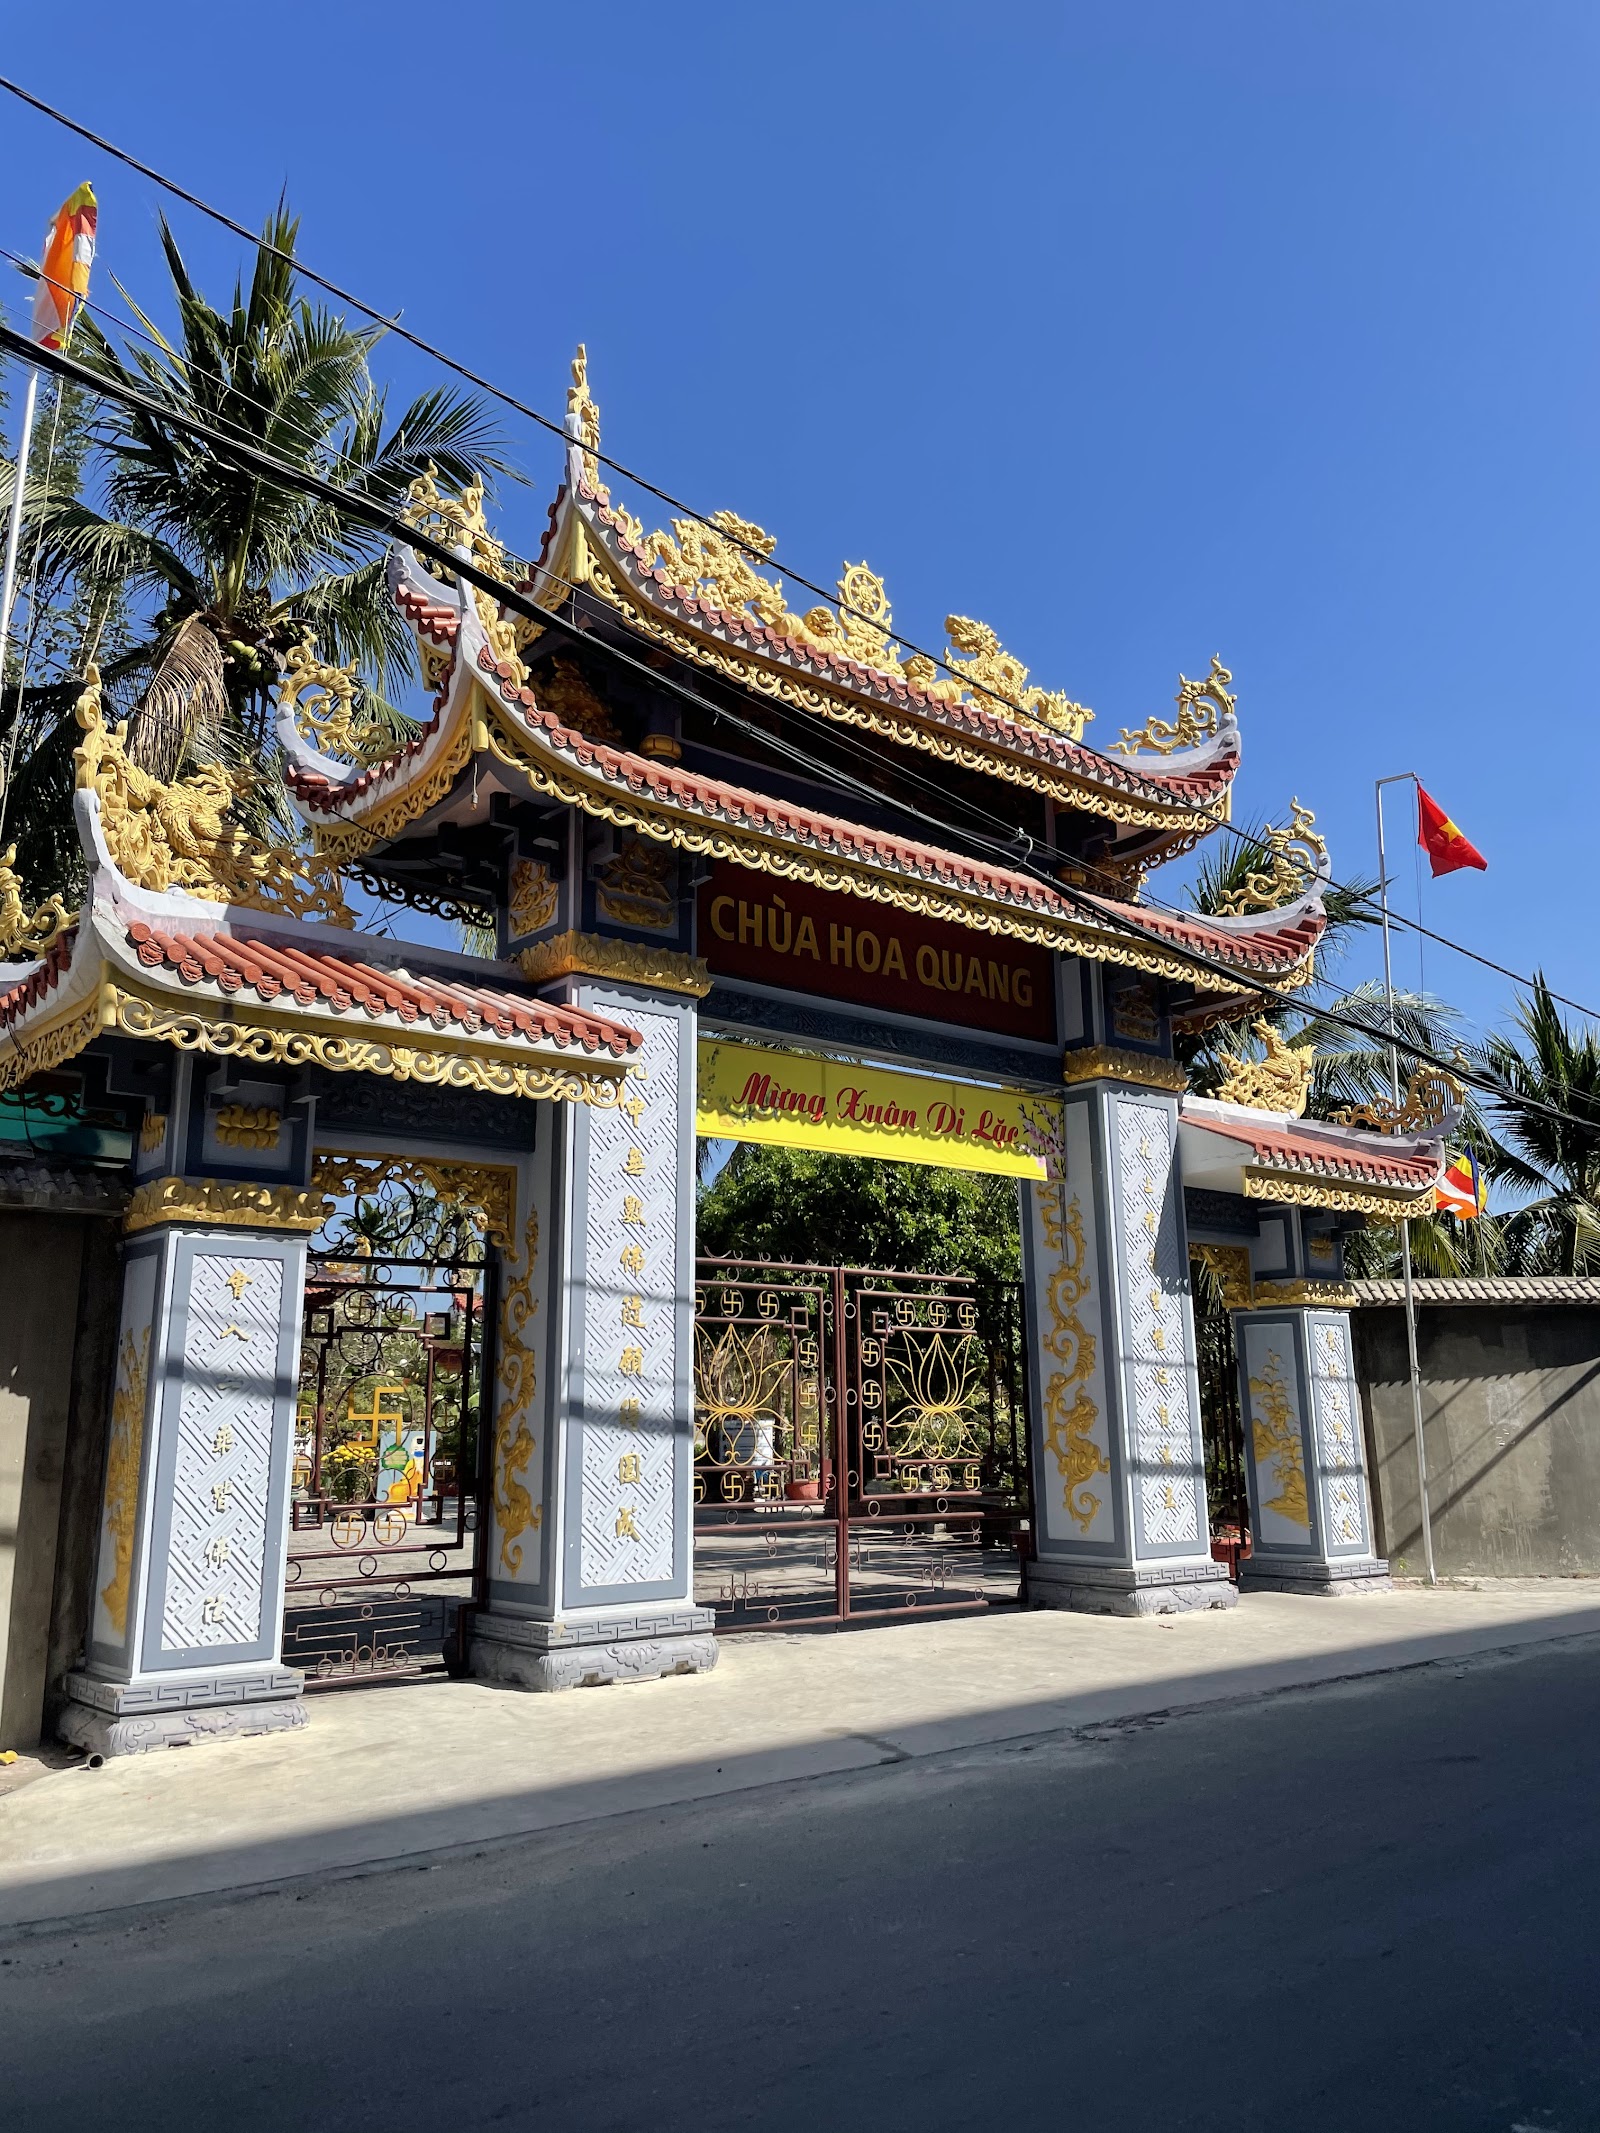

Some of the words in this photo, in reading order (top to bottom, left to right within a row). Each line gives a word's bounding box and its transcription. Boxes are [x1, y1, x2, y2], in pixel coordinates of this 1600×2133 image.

[710, 893, 820, 961] CHÙA
[829, 922, 908, 981] HOA
[915, 944, 1034, 1008] QUANG
[731, 1071, 827, 1123] Mừng
[836, 1086, 918, 1130] Xuân
[970, 1108, 1020, 1149] Lặc
